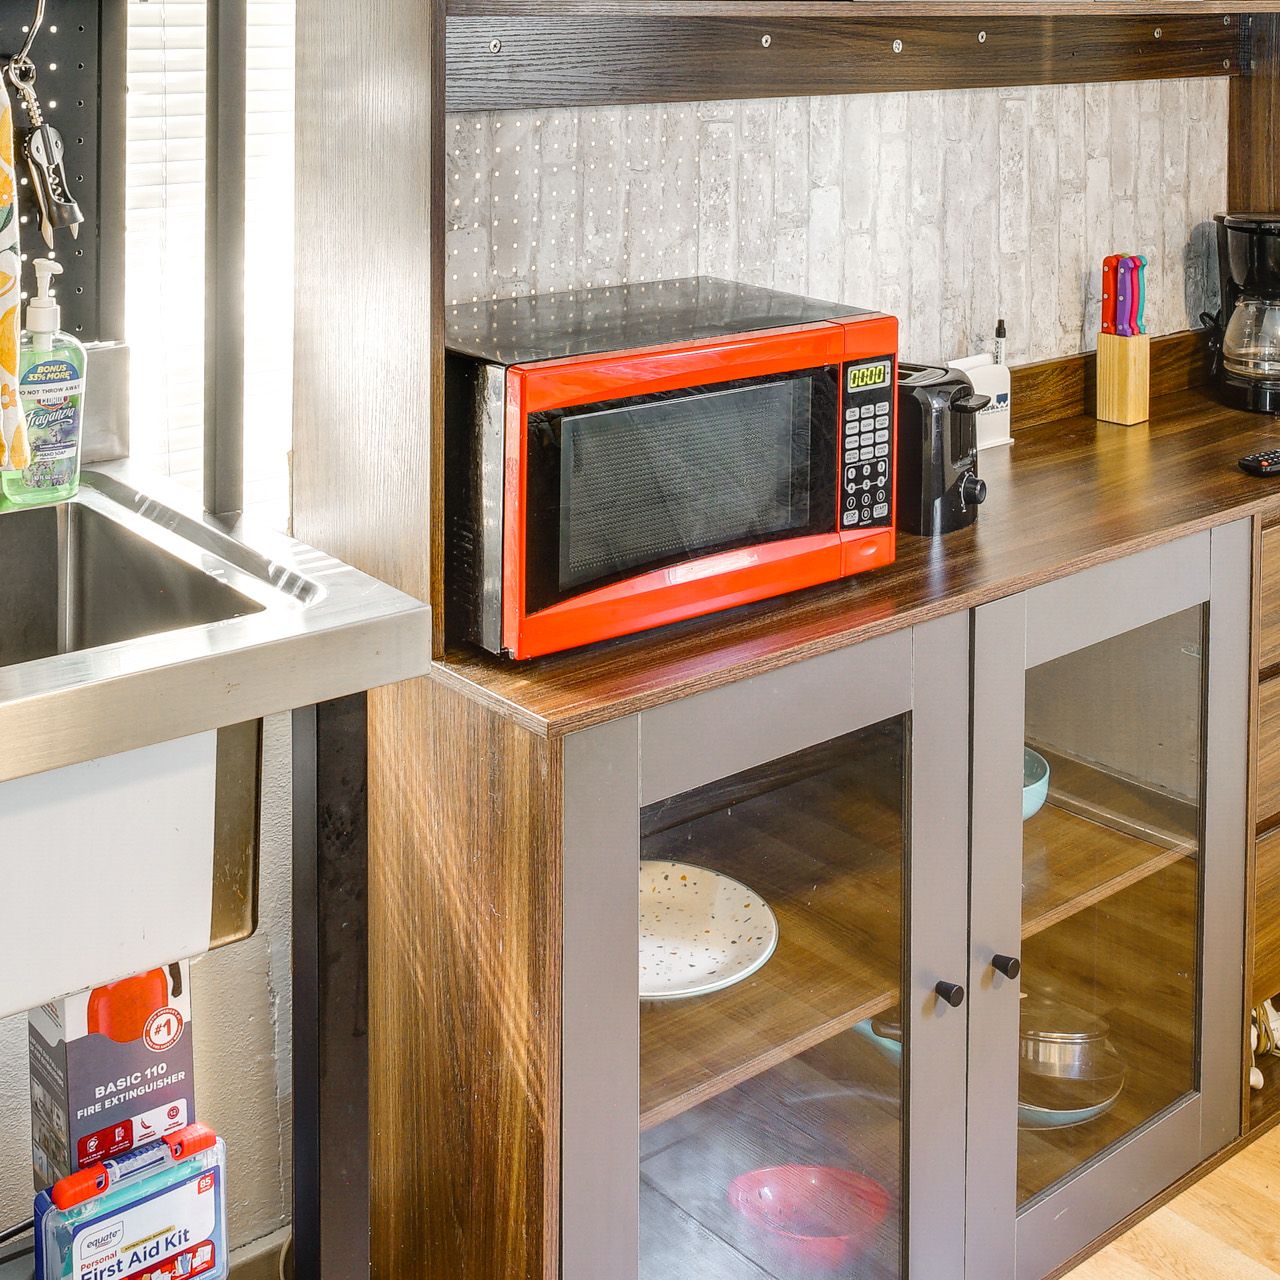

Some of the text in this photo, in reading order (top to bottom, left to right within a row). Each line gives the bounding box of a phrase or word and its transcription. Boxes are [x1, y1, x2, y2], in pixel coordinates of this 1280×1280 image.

[36, 364, 67, 374] BONUS
[25, 404, 75, 431] Fraganzia
[154, 1018, 171, 1036] #1
[95, 1062, 167, 1099] BASIC 110
[77, 1071, 186, 1120] FIRE EXTINGUISHER
[200, 1177, 211, 1188] 85
[86, 1231, 118, 1249] equate
[128, 1240, 160, 1269] Aid
[165, 1228, 190, 1252] Kit
[80, 1250, 117, 1272] Personal
